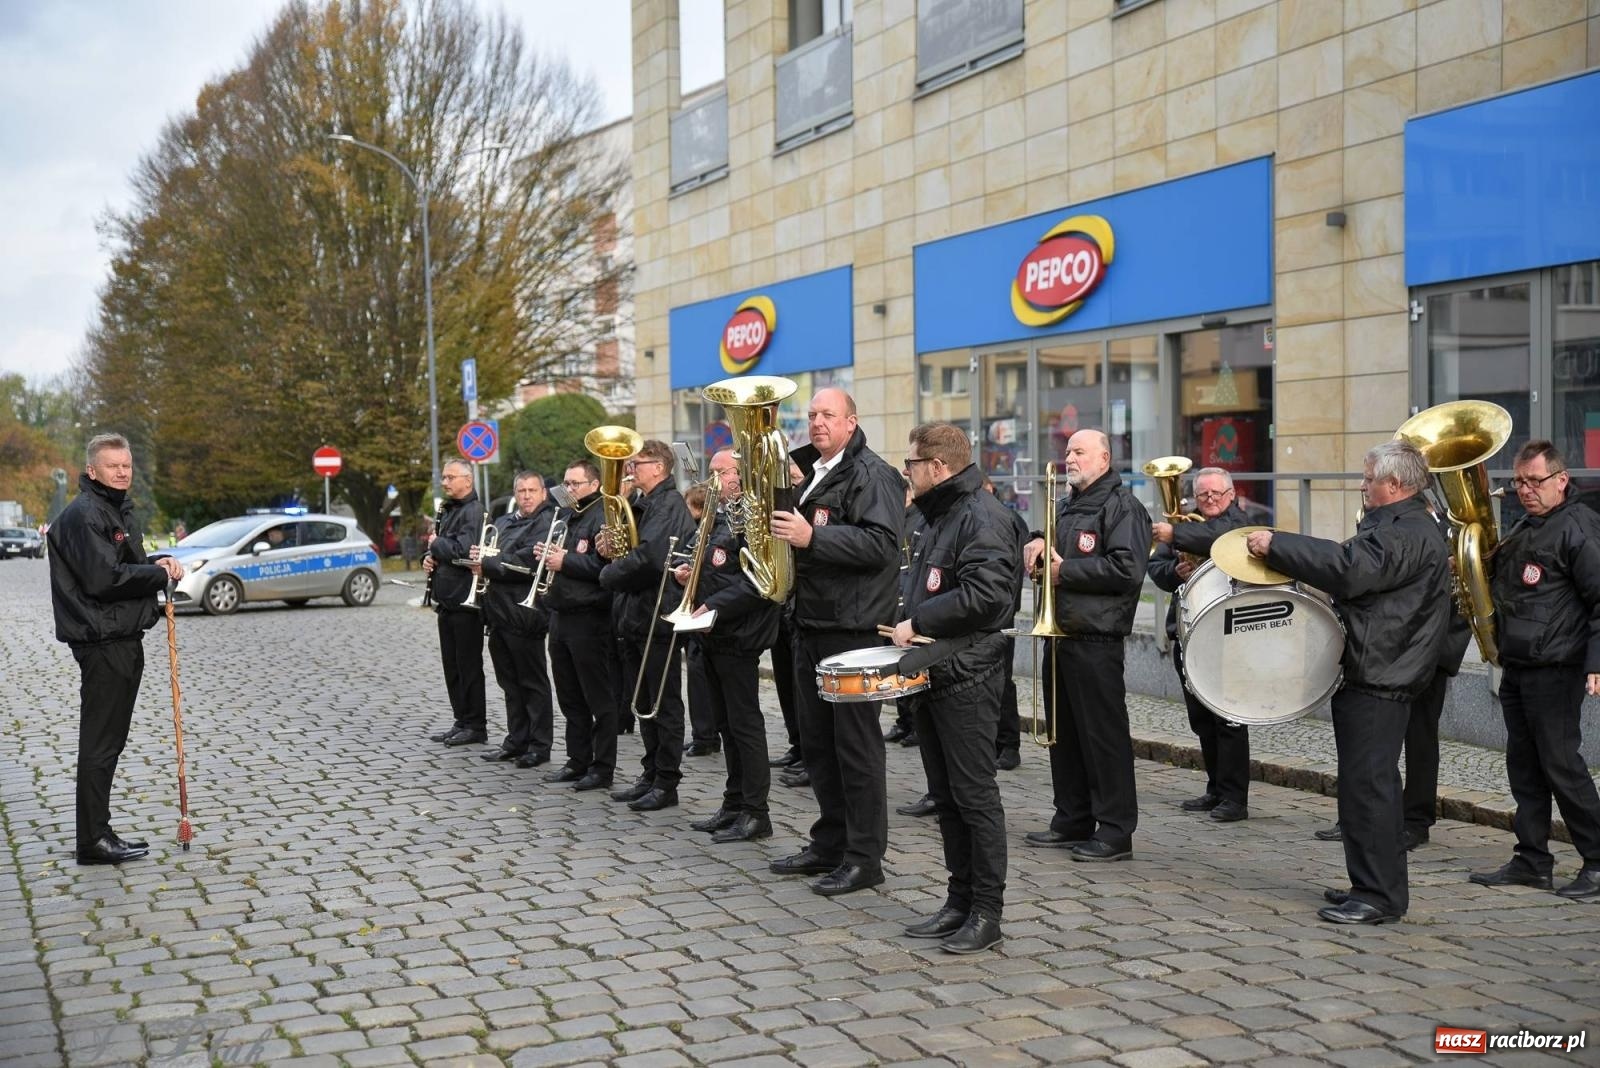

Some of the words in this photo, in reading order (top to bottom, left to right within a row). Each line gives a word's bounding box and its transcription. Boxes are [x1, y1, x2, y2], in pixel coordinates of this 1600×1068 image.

[1024, 250, 1091, 293] PEPCO
[726, 320, 762, 350] PEPCO
[259, 561, 292, 577] POLICJA
[1233, 623, 1267, 634] POWER
[1269, 618, 1294, 629] BEAT
